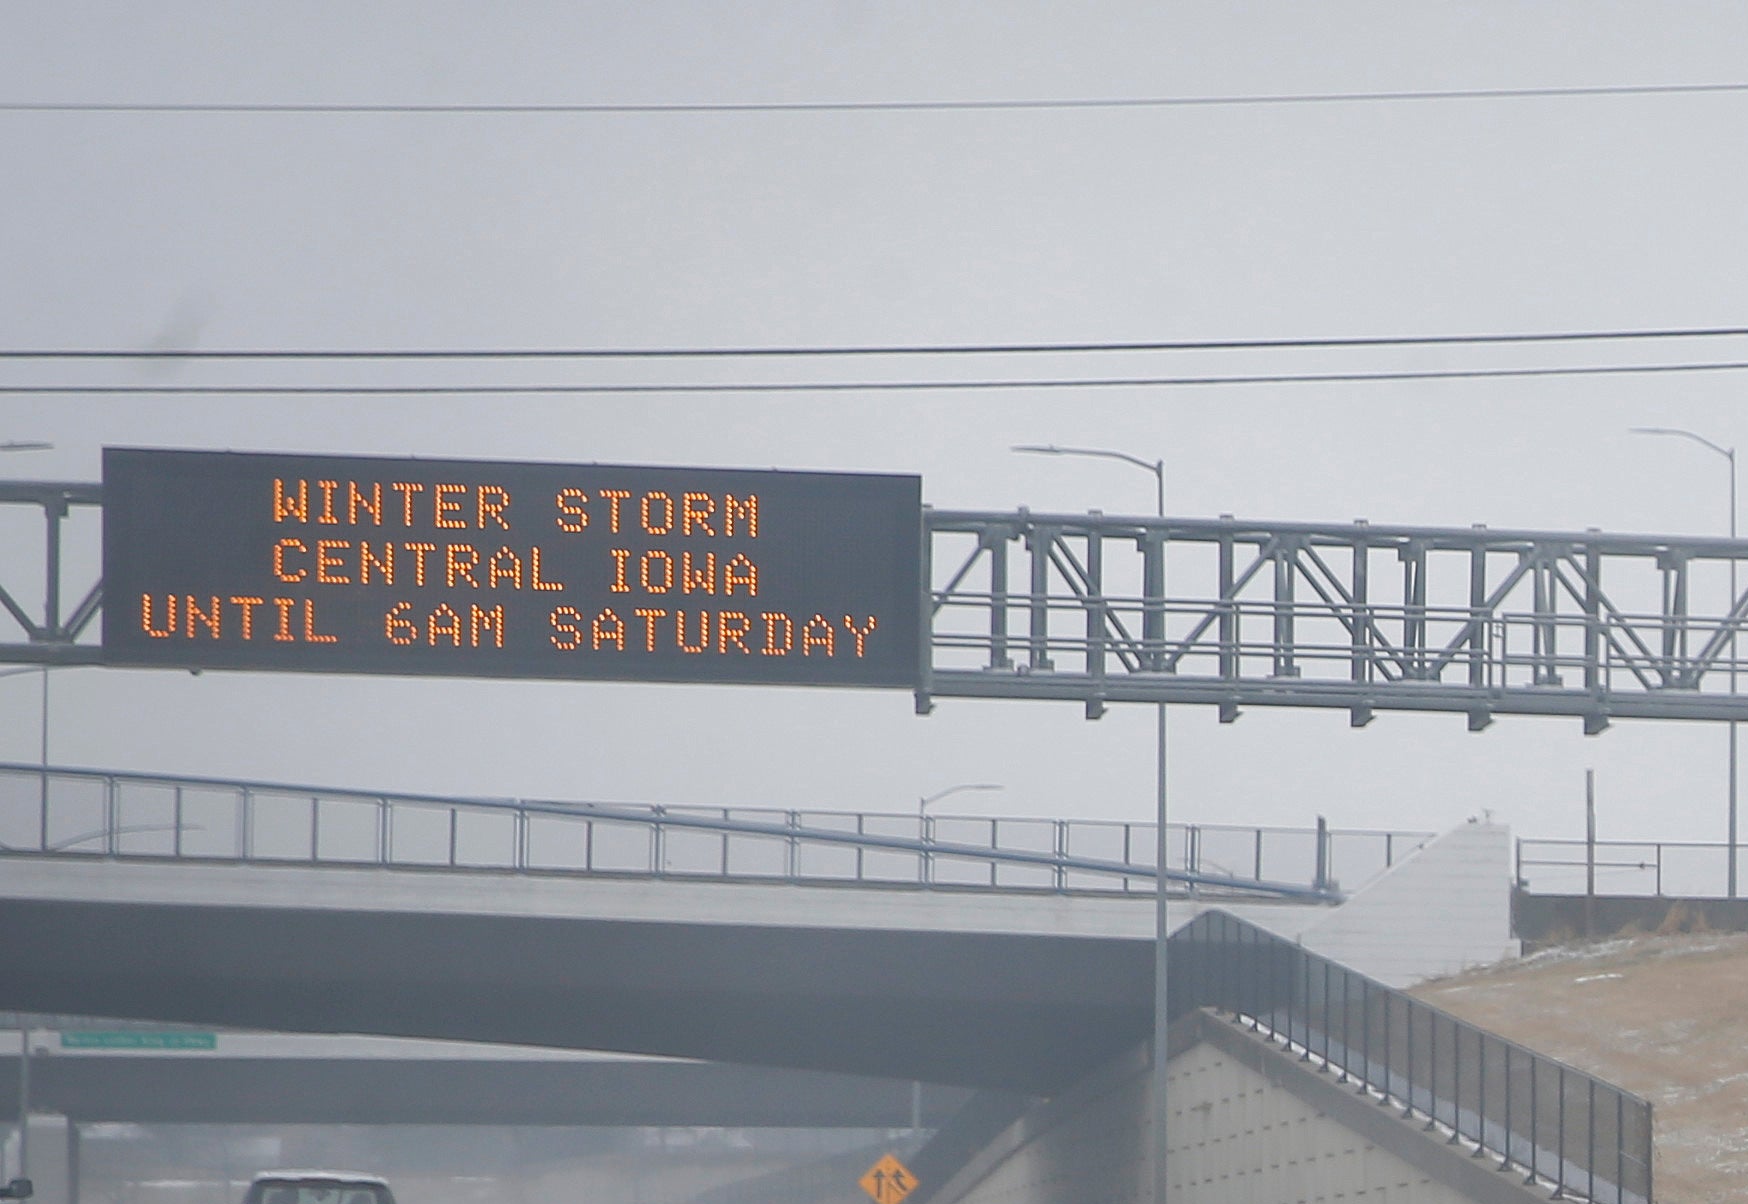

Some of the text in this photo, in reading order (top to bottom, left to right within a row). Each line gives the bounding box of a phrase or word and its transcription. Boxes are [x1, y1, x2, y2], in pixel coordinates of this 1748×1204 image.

[273, 478, 760, 538] WINTER STORM
[273, 537, 759, 597] CENTRAL IOWA
[141, 593, 878, 657] UNTIL 6AM SATURDAY
